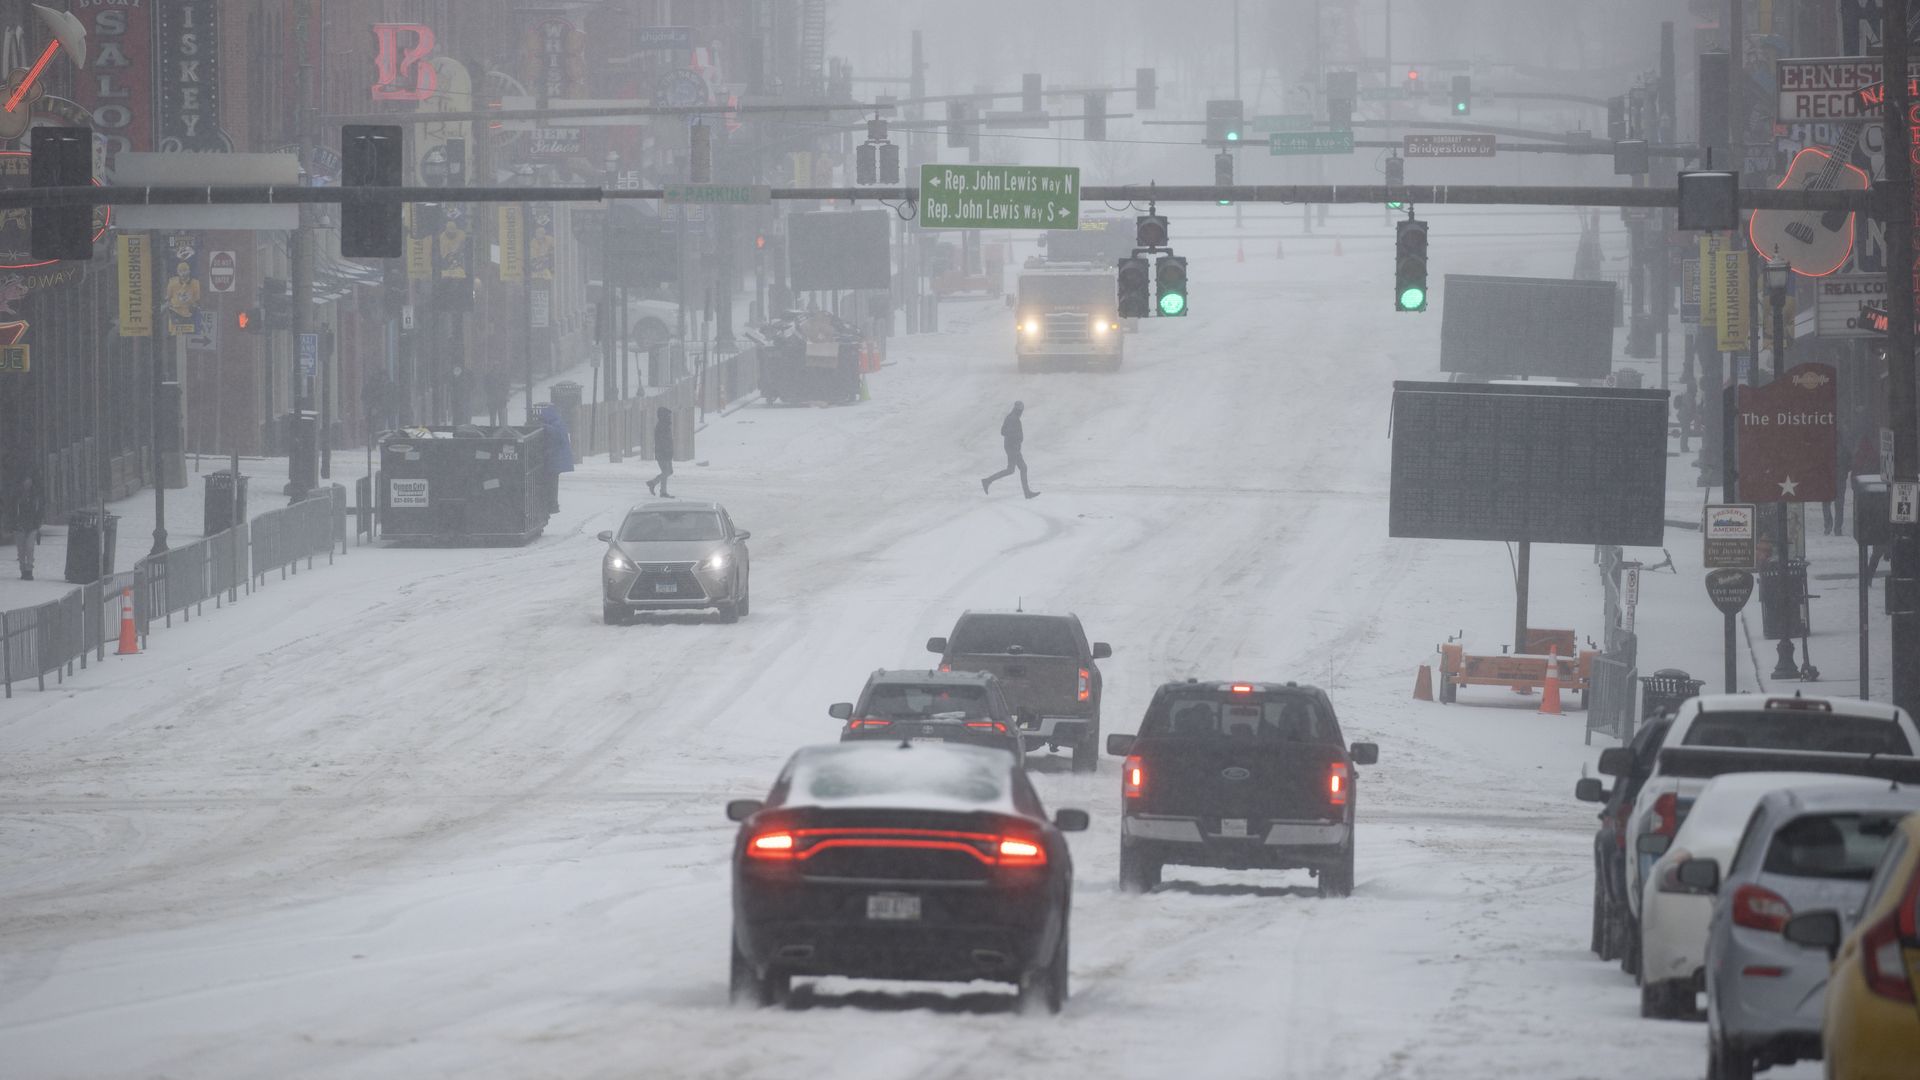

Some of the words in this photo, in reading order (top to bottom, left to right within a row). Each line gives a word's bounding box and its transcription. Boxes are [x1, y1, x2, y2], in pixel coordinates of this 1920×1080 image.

[529, 128, 581, 140] BENT
[529, 140, 581, 154] Saloon
[1408, 144, 1477, 156] Bridgestone
[944, 169, 969, 194] Rep.
[972, 170, 1001, 191] John
[1003, 170, 1037, 192] Lewis
[1041, 175, 1061, 195] Way
[1064, 174, 1073, 195] N
[684, 187, 751, 202] PARKING
[927, 198, 952, 223] Rep.
[954, 198, 983, 220] John
[986, 199, 1020, 220] Lewis
[1023, 205, 1043, 223] Way
[1047, 201, 1055, 222] S
[128, 245, 142, 323] SMASHVILLE
[1824, 282, 1862, 295] REAL
[1726, 262, 1739, 337] SMASHVILLE
[1742, 412, 1770, 426] The
[1777, 411, 1834, 425] District
[1712, 508, 1747, 520] PRESERVE
